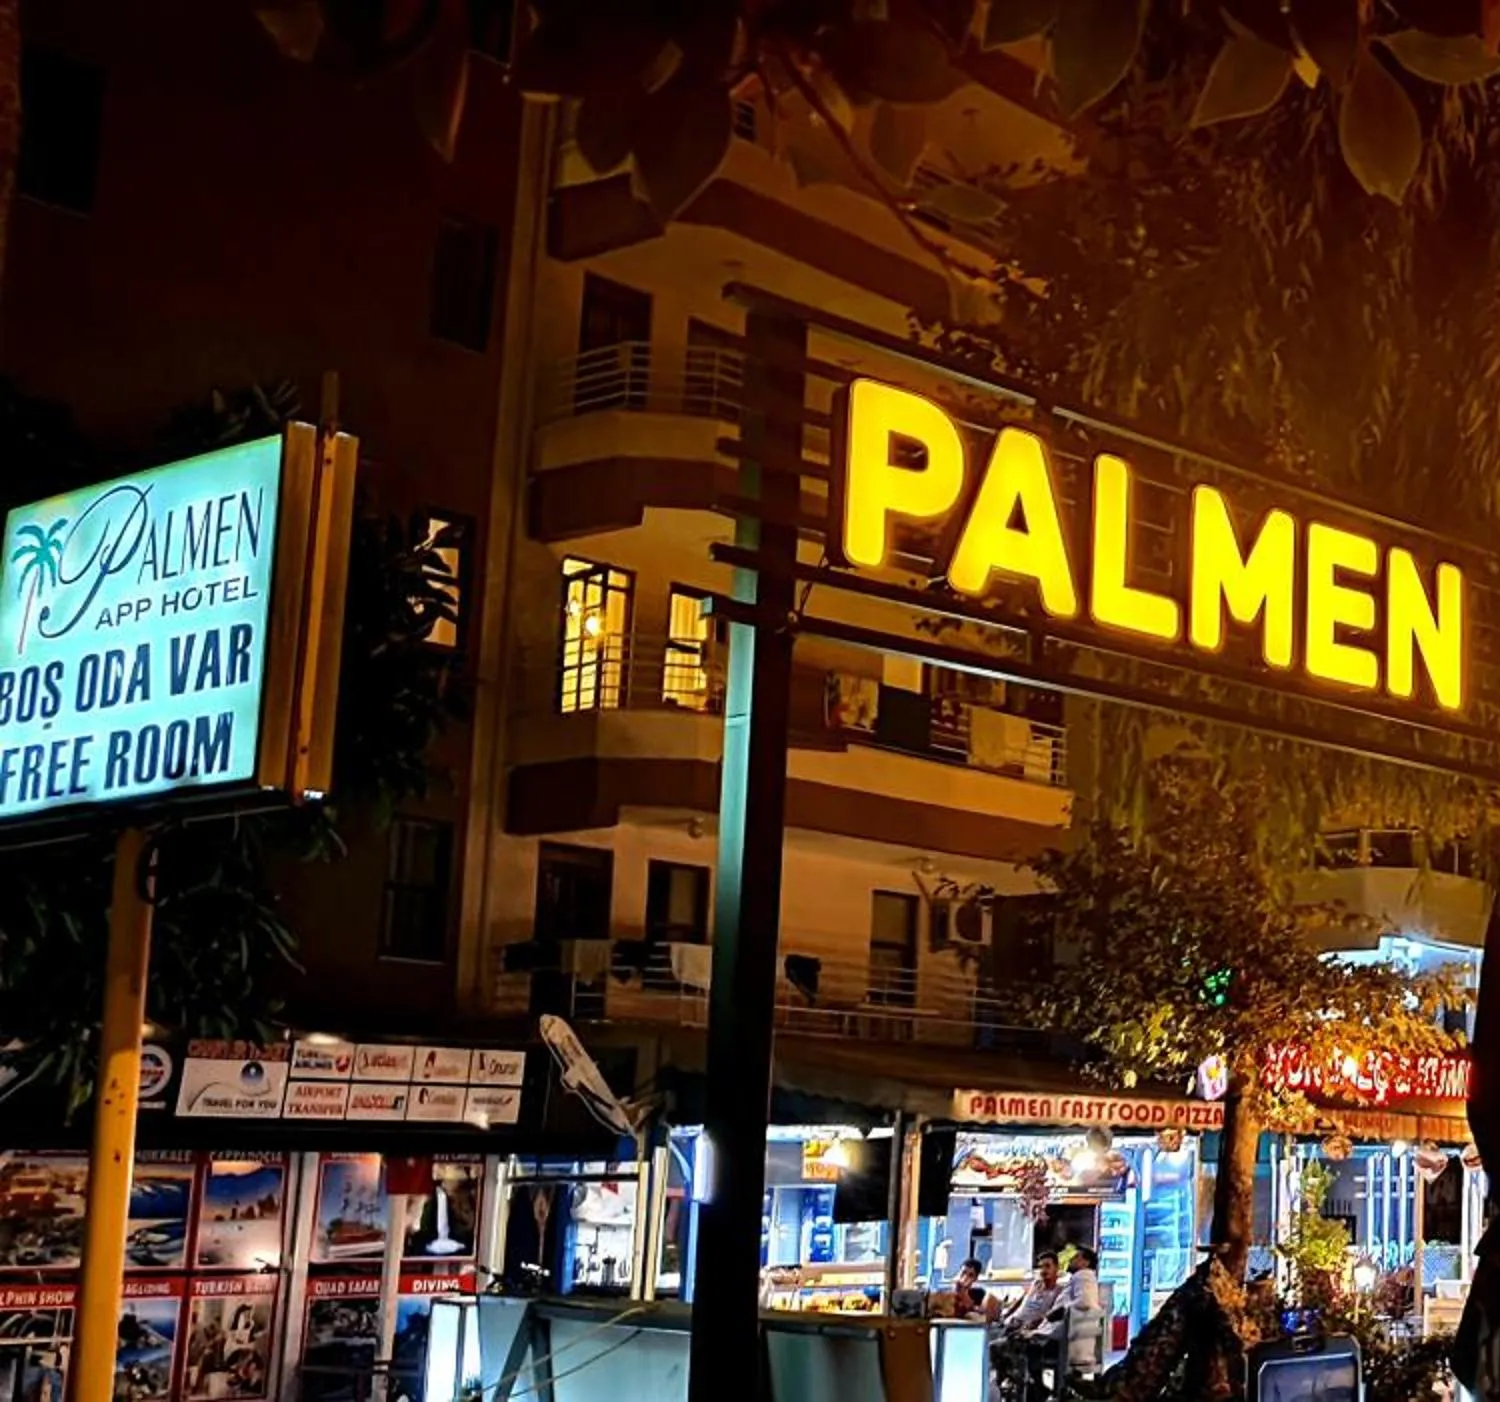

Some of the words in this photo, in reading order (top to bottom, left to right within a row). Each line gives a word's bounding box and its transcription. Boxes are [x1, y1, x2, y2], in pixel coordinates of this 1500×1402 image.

[842, 377, 1463, 711] PALMEN
[38, 483, 264, 639] PALMEN
[95, 598, 152, 630] APP
[161, 575, 259, 617] HOTEL
[0, 660, 64, 730] BOŞ
[76, 643, 151, 713] ODA
[169, 622, 253, 695] VAR
[0, 735, 94, 804] FREE
[104, 711, 235, 790] ROOM
[294, 1086, 343, 1097] AIRPORT
[257, 1100, 277, 1110] YOU
[288, 1103, 343, 1115] TRANSFER
[969, 1095, 1052, 1118] PALMEN
[1059, 1099, 1168, 1124] FASTFOOD
[1174, 1104, 1227, 1126] PIZZA
[124, 1282, 171, 1295] AGLIDING
[194, 1280, 243, 1295] TURKISH
[315, 1280, 345, 1294] QUAD
[348, 1280, 380, 1294] SAFAR
[412, 1279, 460, 1293] DIVING
[39, 1289, 76, 1306] SHOW
